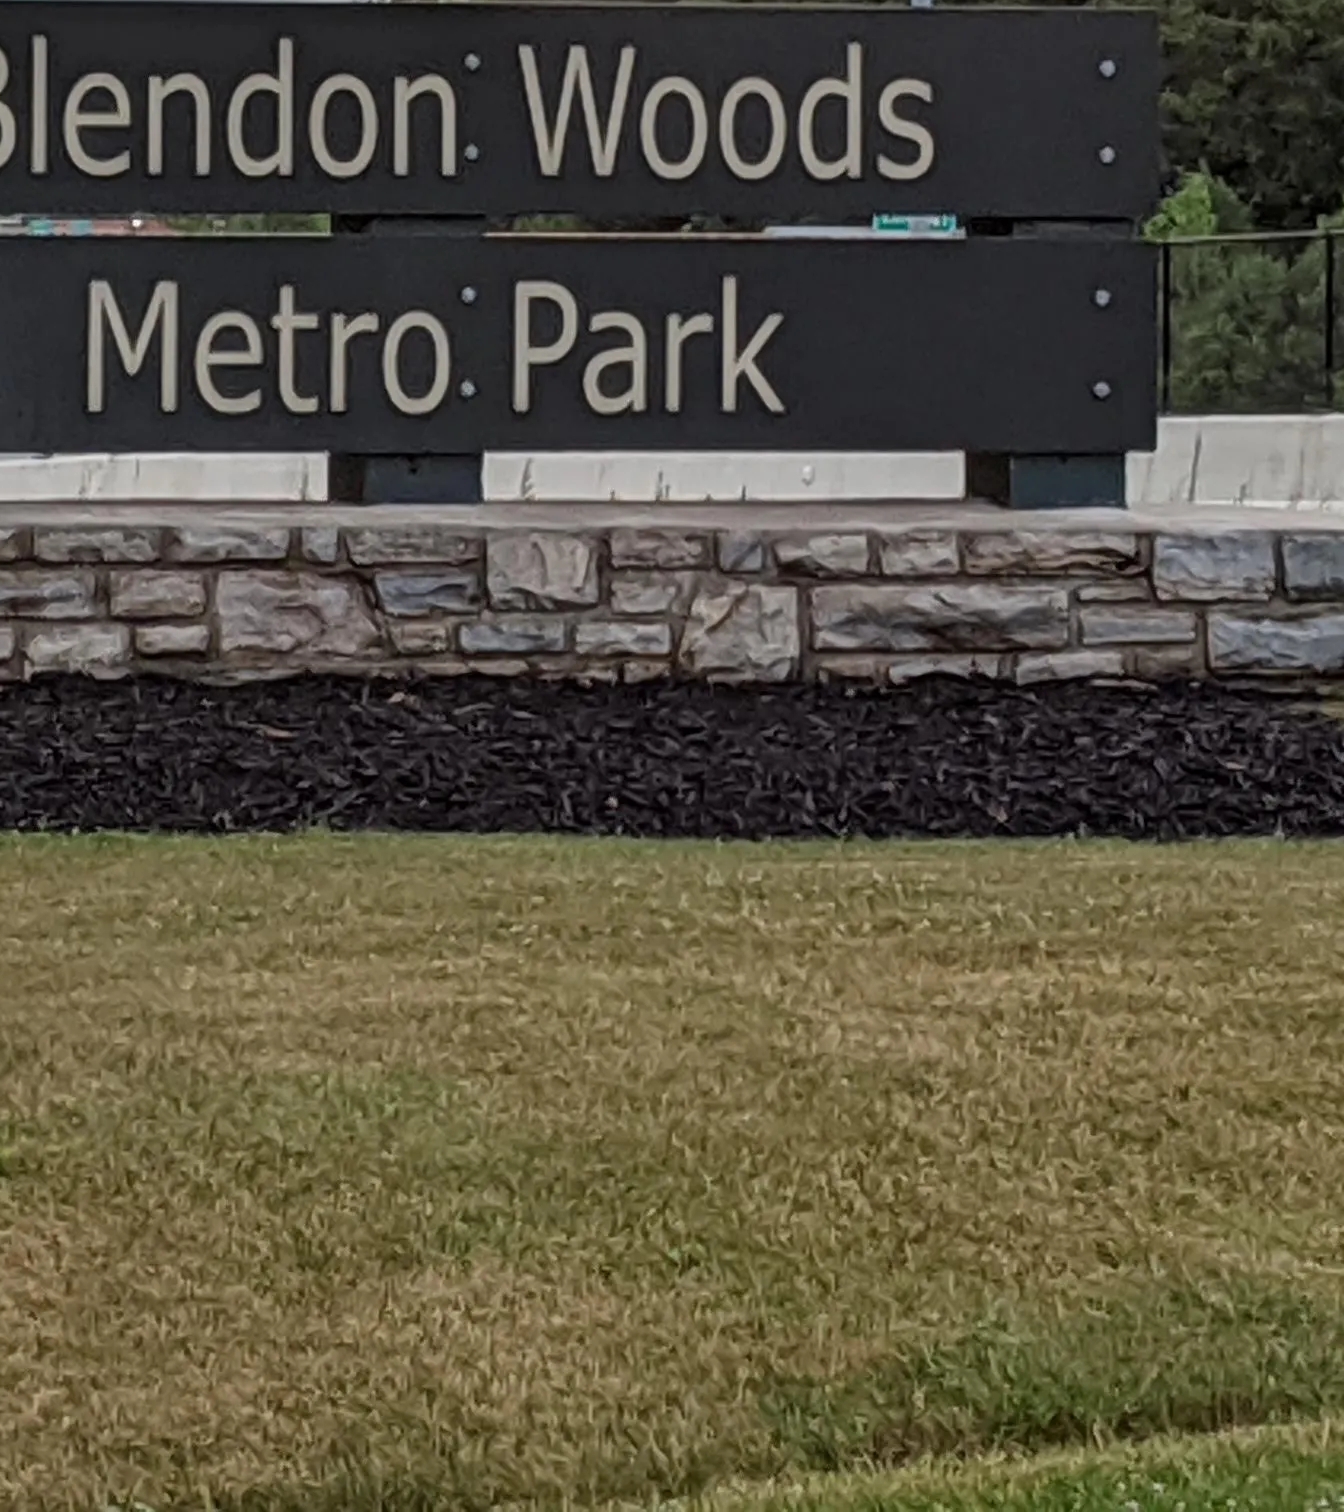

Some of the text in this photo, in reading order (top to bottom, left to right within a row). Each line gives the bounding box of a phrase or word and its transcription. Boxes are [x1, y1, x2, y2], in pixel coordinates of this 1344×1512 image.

[517, 41, 935, 181] Woods
[86, 275, 786, 415] Metro Park
